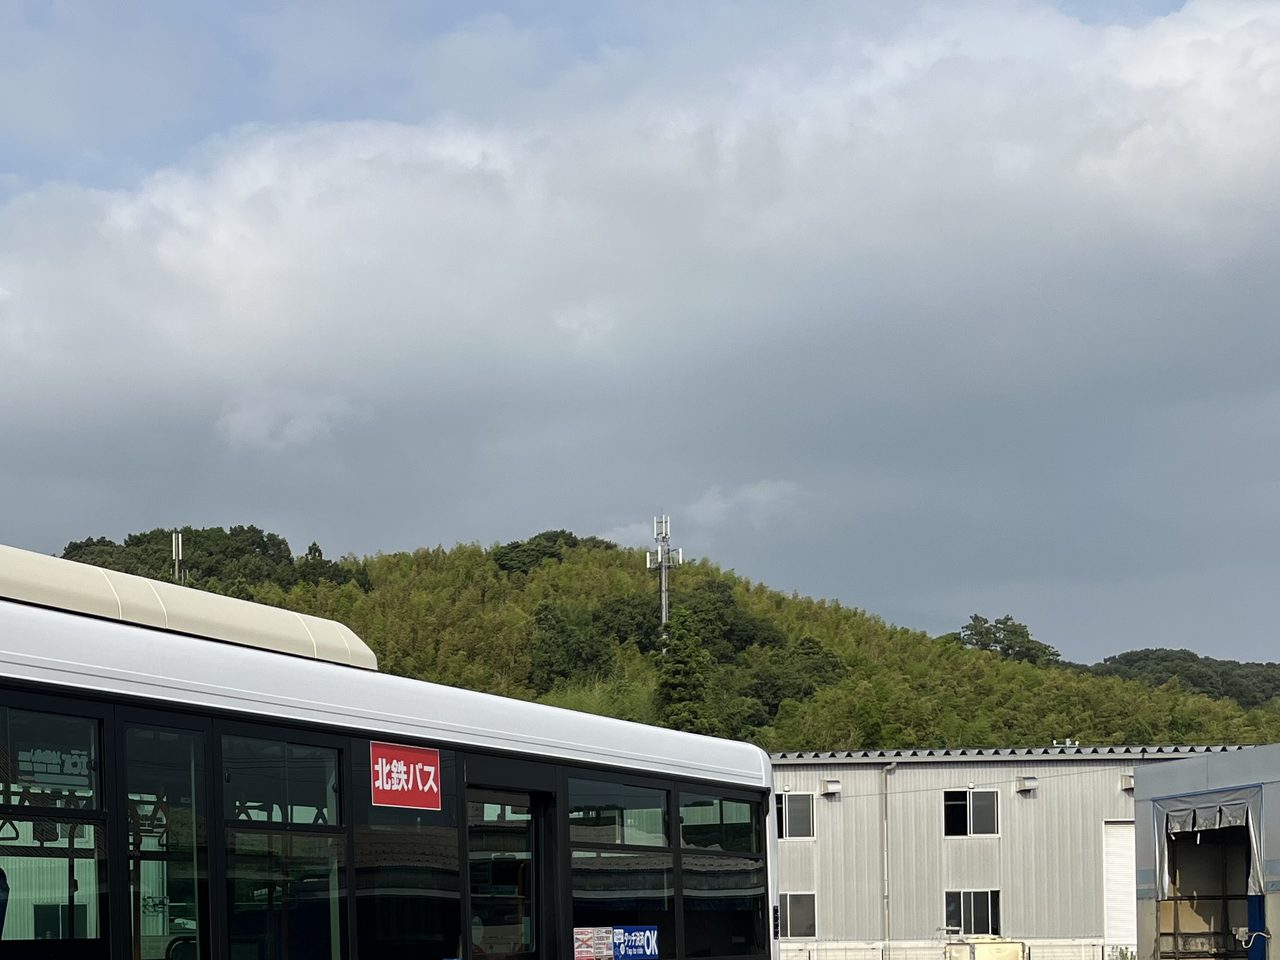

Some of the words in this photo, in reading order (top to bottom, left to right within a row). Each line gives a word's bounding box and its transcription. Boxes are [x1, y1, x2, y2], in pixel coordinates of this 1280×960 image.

[374, 757, 438, 794] 北鉄バス
[644, 930, 659, 955] OK
